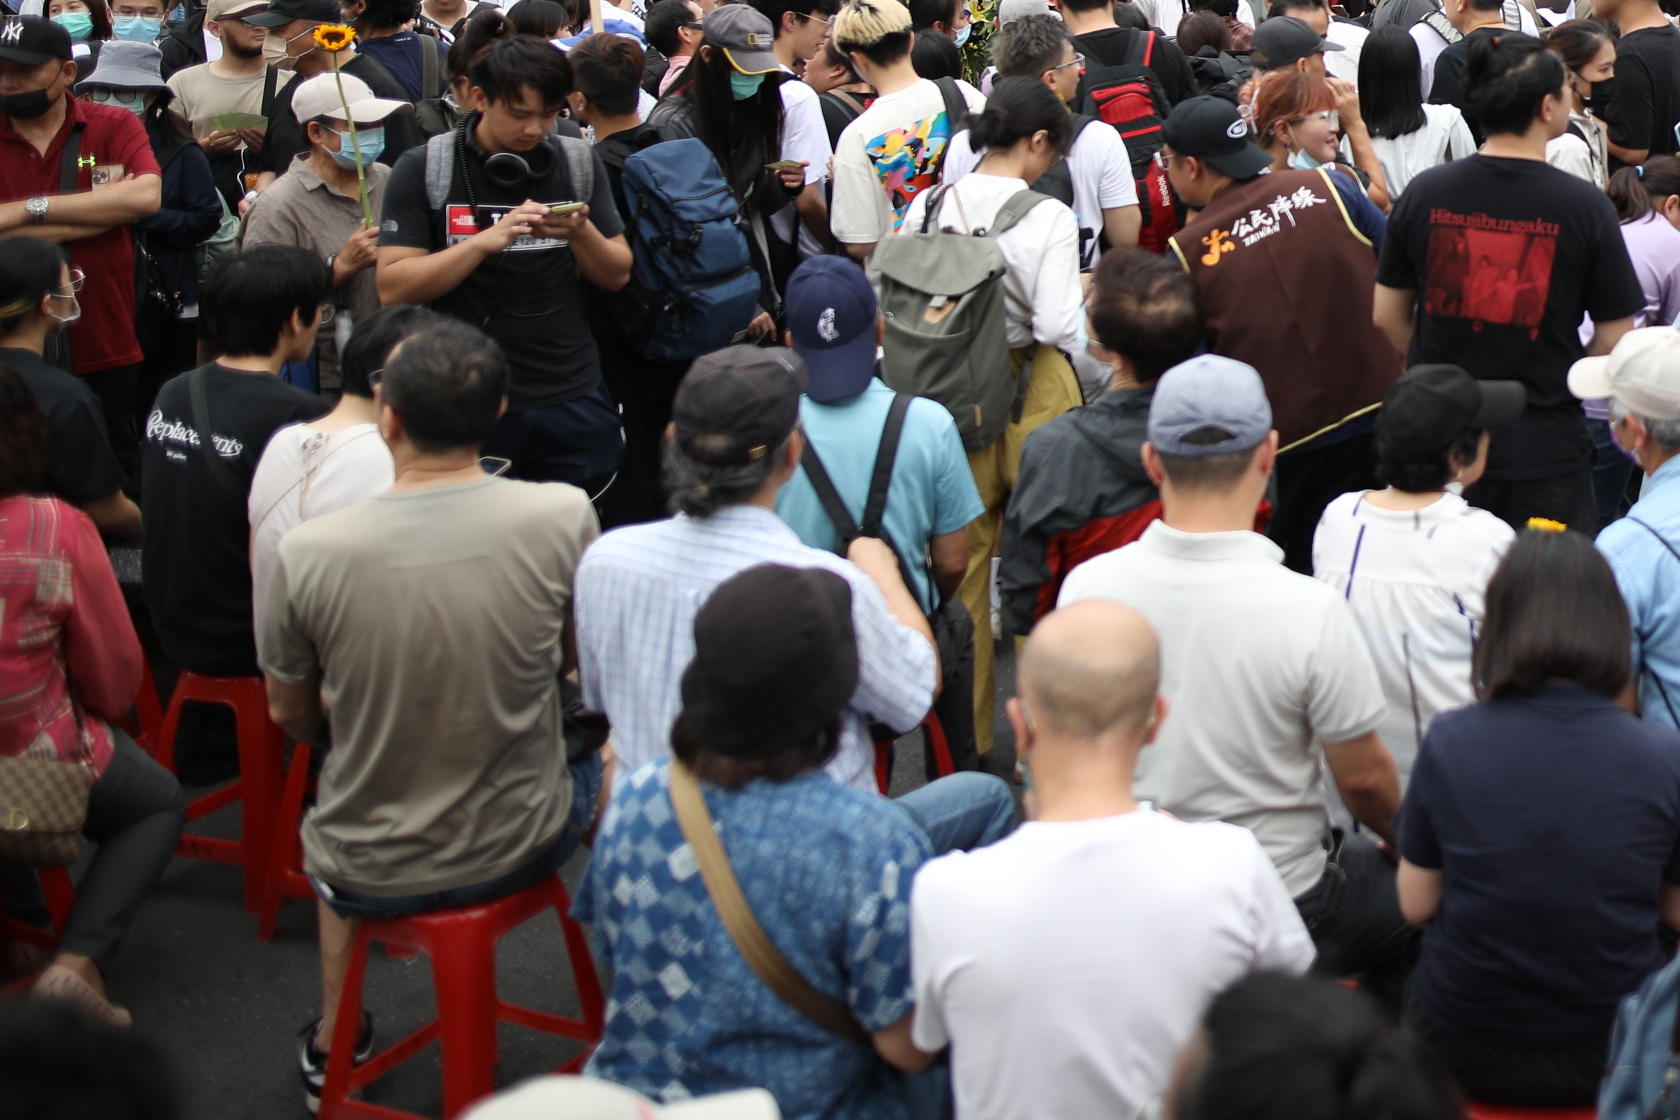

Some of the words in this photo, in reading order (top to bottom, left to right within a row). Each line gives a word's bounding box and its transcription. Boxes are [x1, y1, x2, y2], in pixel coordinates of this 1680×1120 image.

[1157, 174, 1171, 207] Reebok
[1230, 186, 1327, 238] 公民陣線
[1429, 208, 1561, 237] Hitsujibungaku
[1242, 222, 1281, 247] TAIWAN
